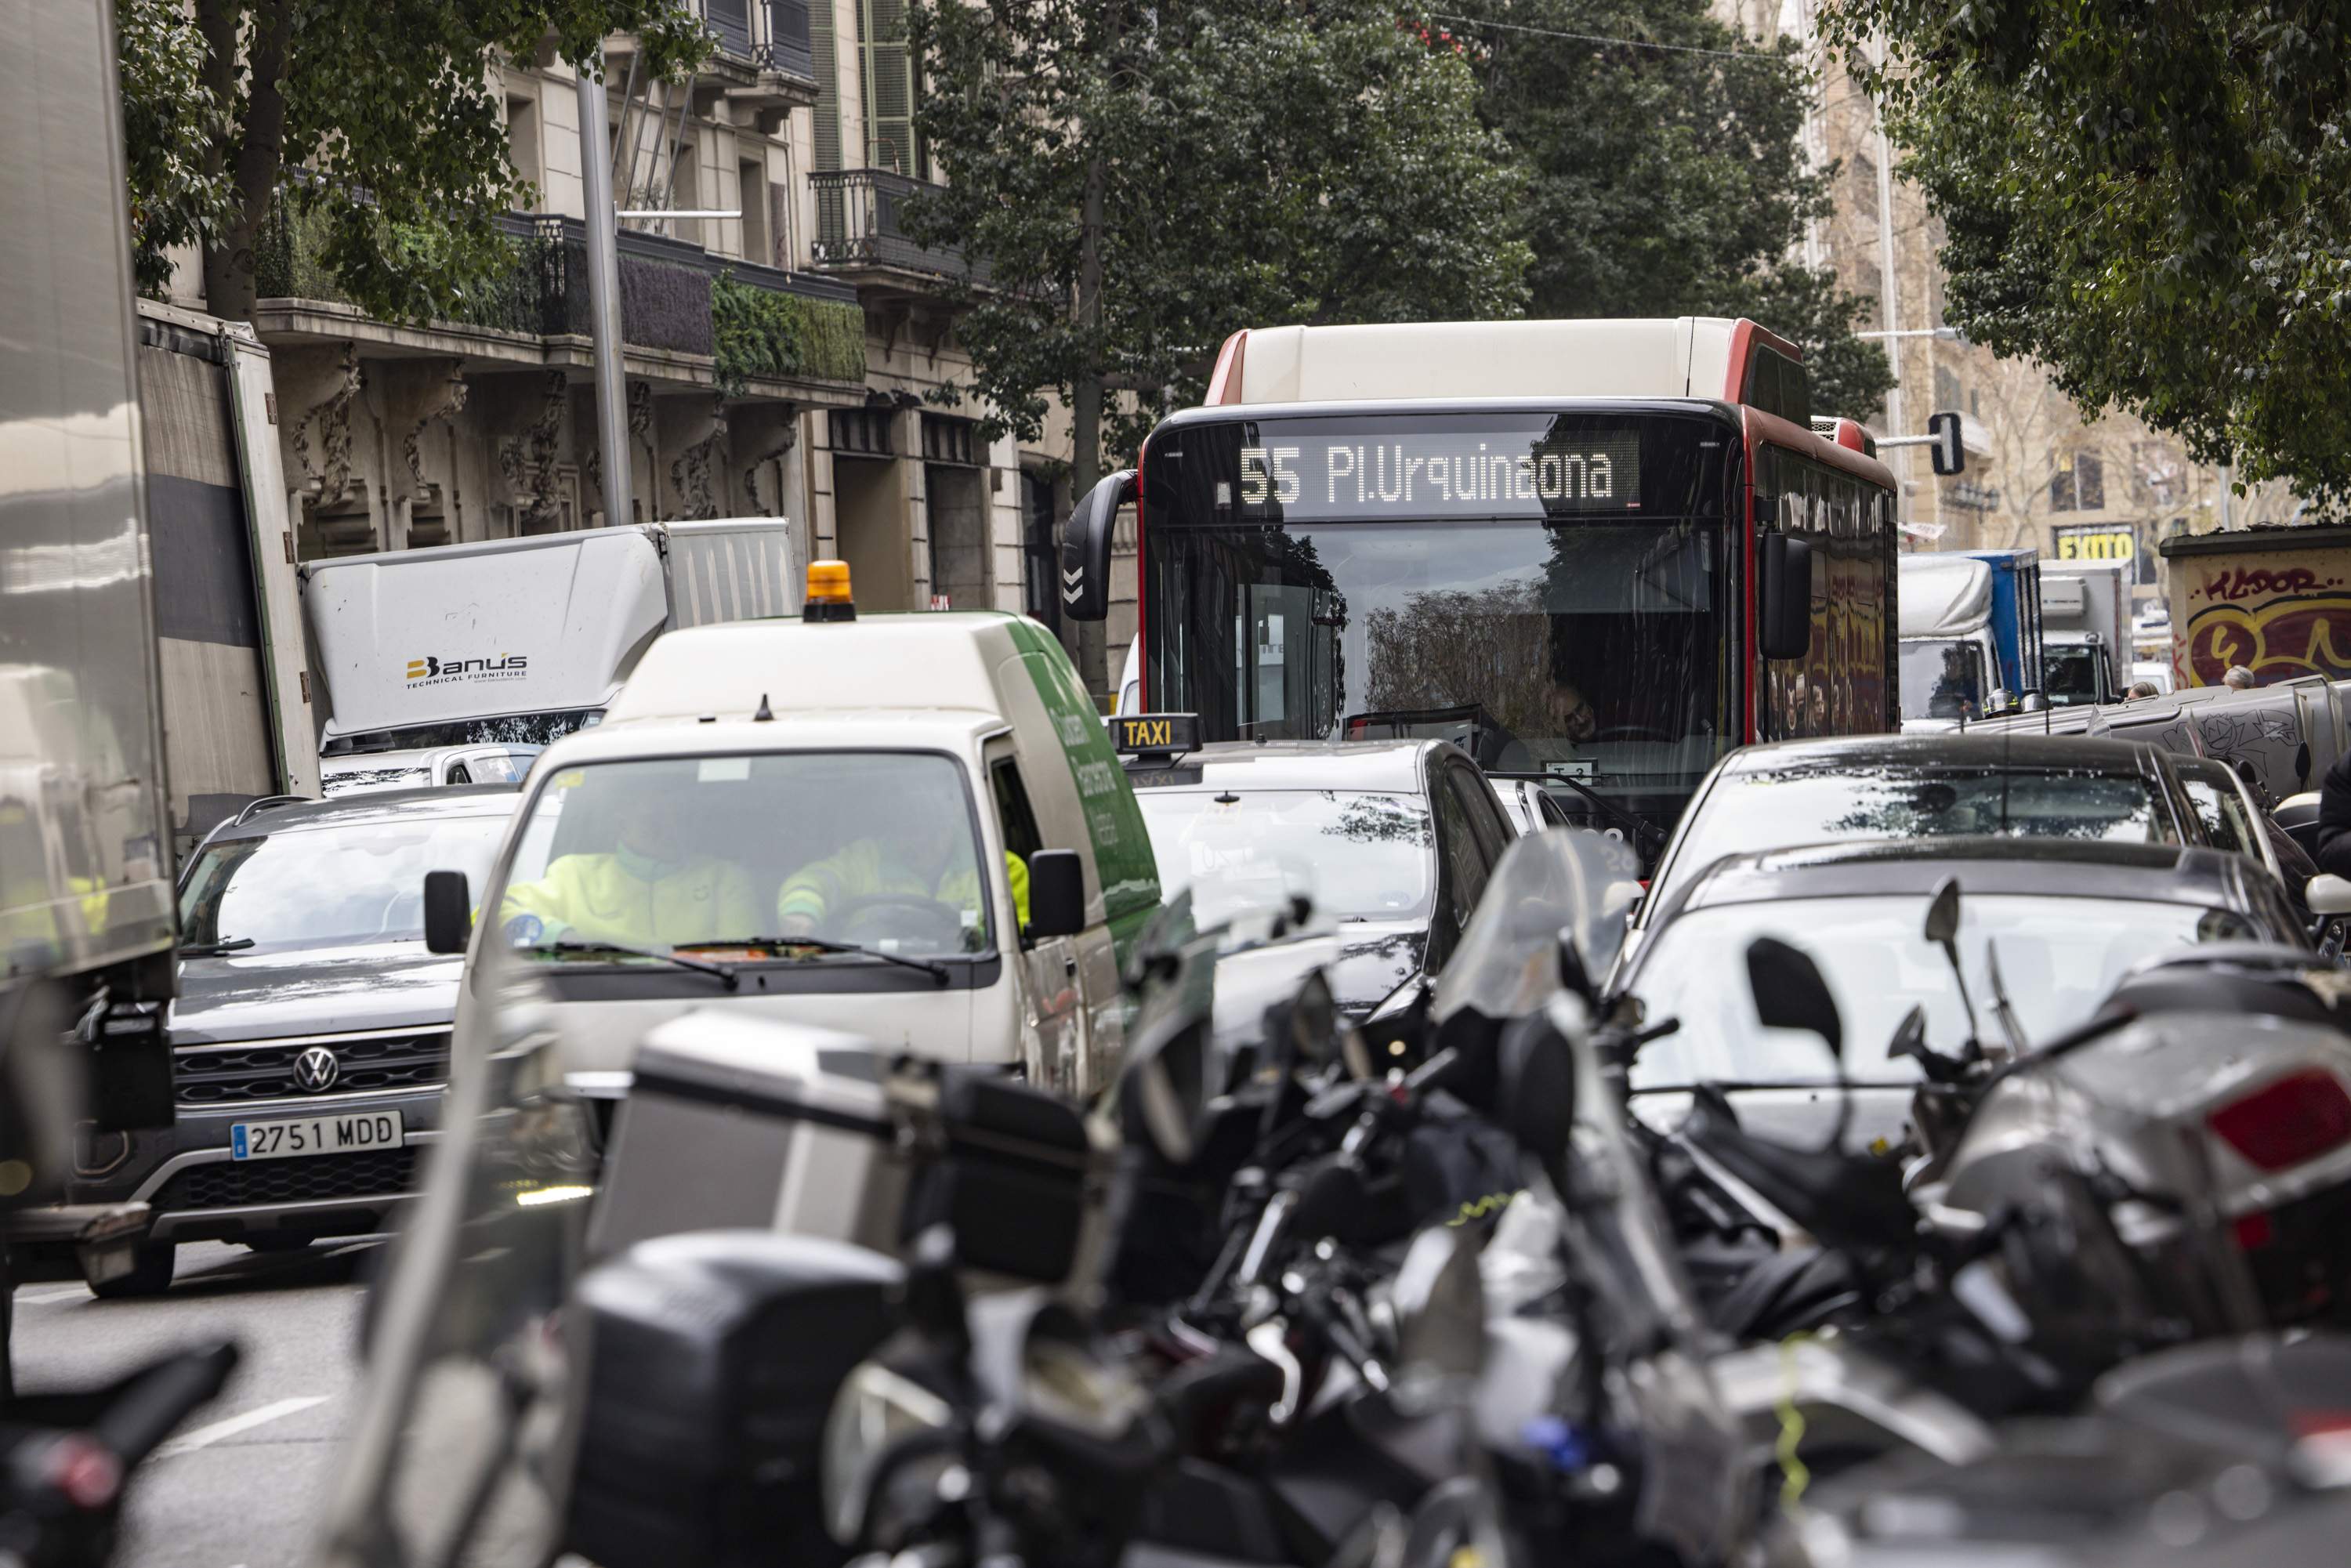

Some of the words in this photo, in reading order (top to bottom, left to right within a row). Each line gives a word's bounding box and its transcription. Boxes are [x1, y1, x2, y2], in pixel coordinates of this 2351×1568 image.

[1241, 447, 1301, 505] 55
[1328, 444, 1613, 503] Pl.Urquinaona
[406, 675, 464, 690] TECHNICAL
[467, 670, 527, 680] FURNITURE
[1124, 720, 1171, 746] TAXI
[251, 1122, 323, 1153] 2751
[338, 1117, 392, 1146] MDD
